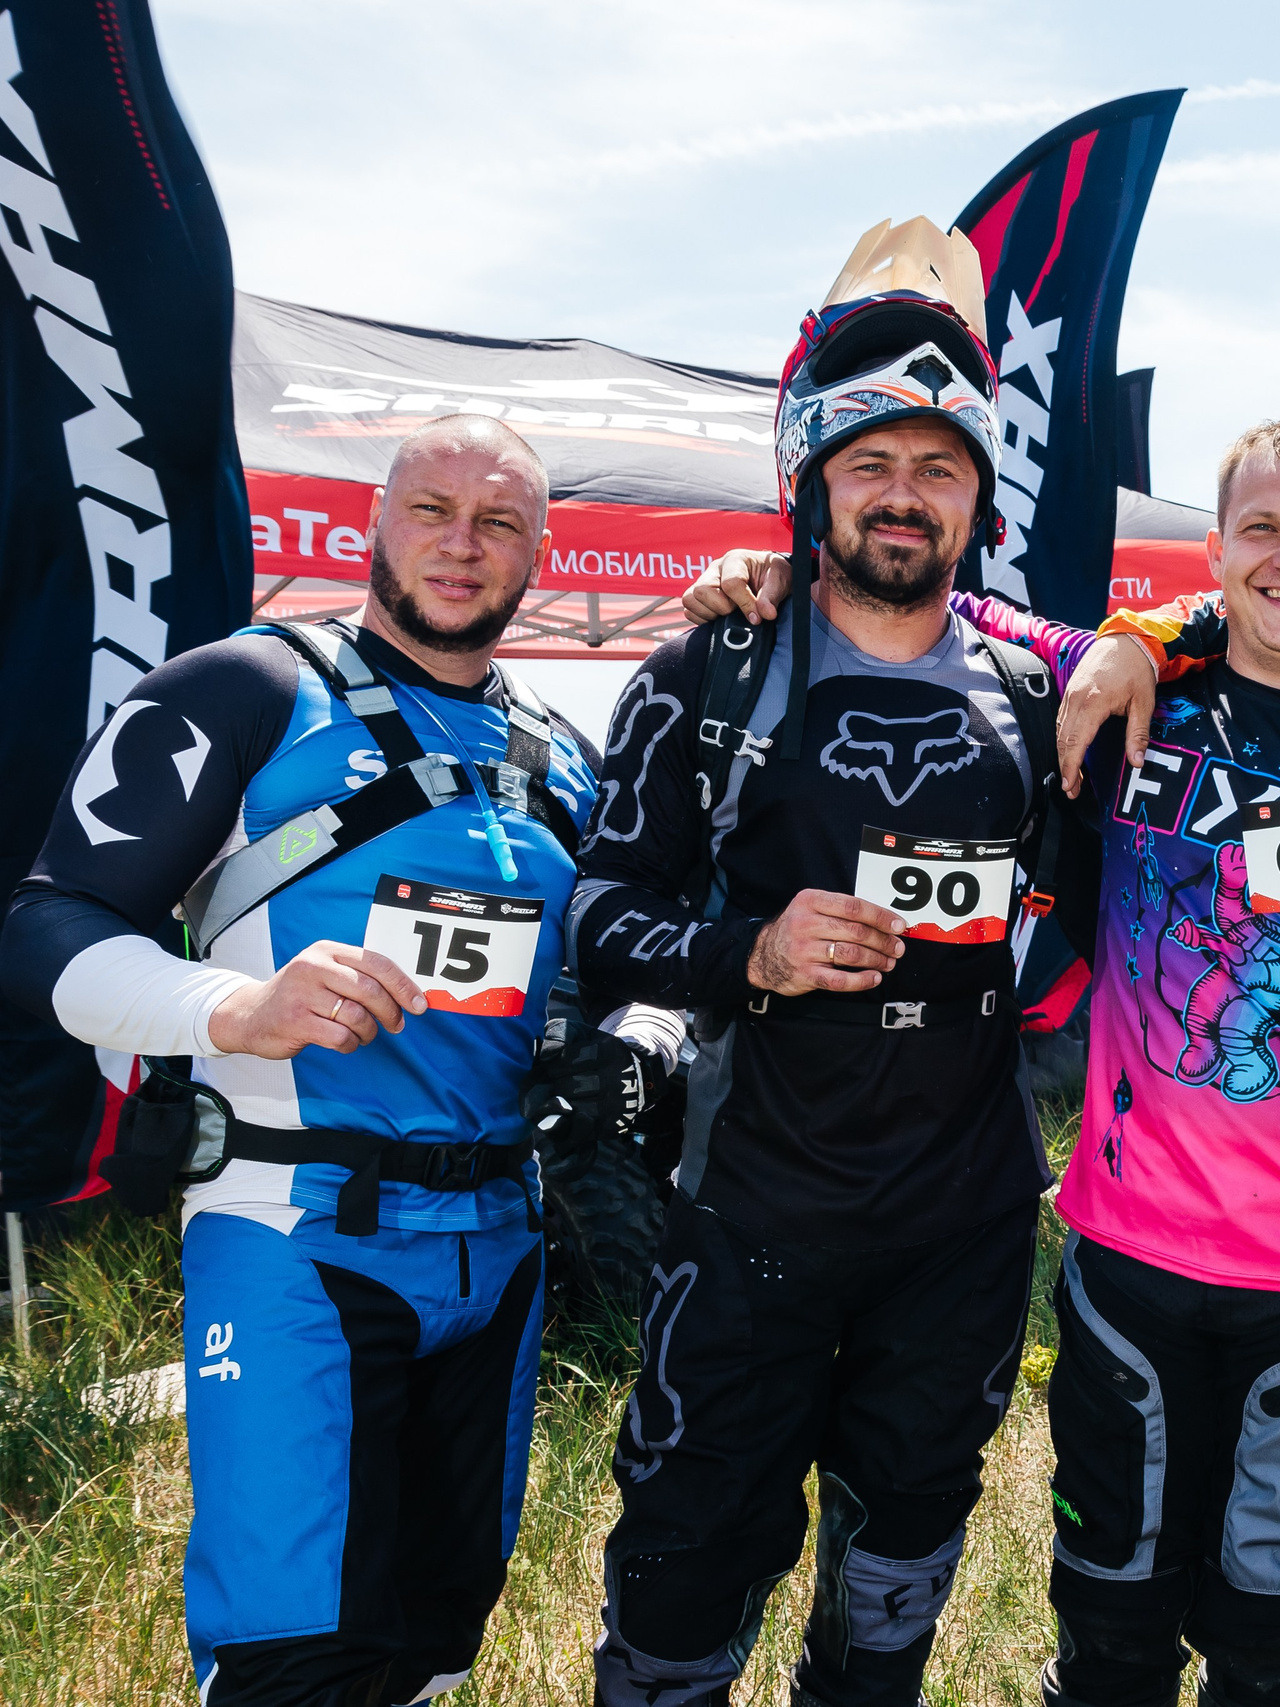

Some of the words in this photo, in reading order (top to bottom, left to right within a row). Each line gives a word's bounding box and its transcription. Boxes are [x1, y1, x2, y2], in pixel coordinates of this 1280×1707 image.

[1108, 577, 1152, 599] СТИ
[890, 866, 980, 917] 90
[413, 920, 491, 983] 15
[595, 909, 713, 961] FOX
[198, 1321, 242, 1382] af
